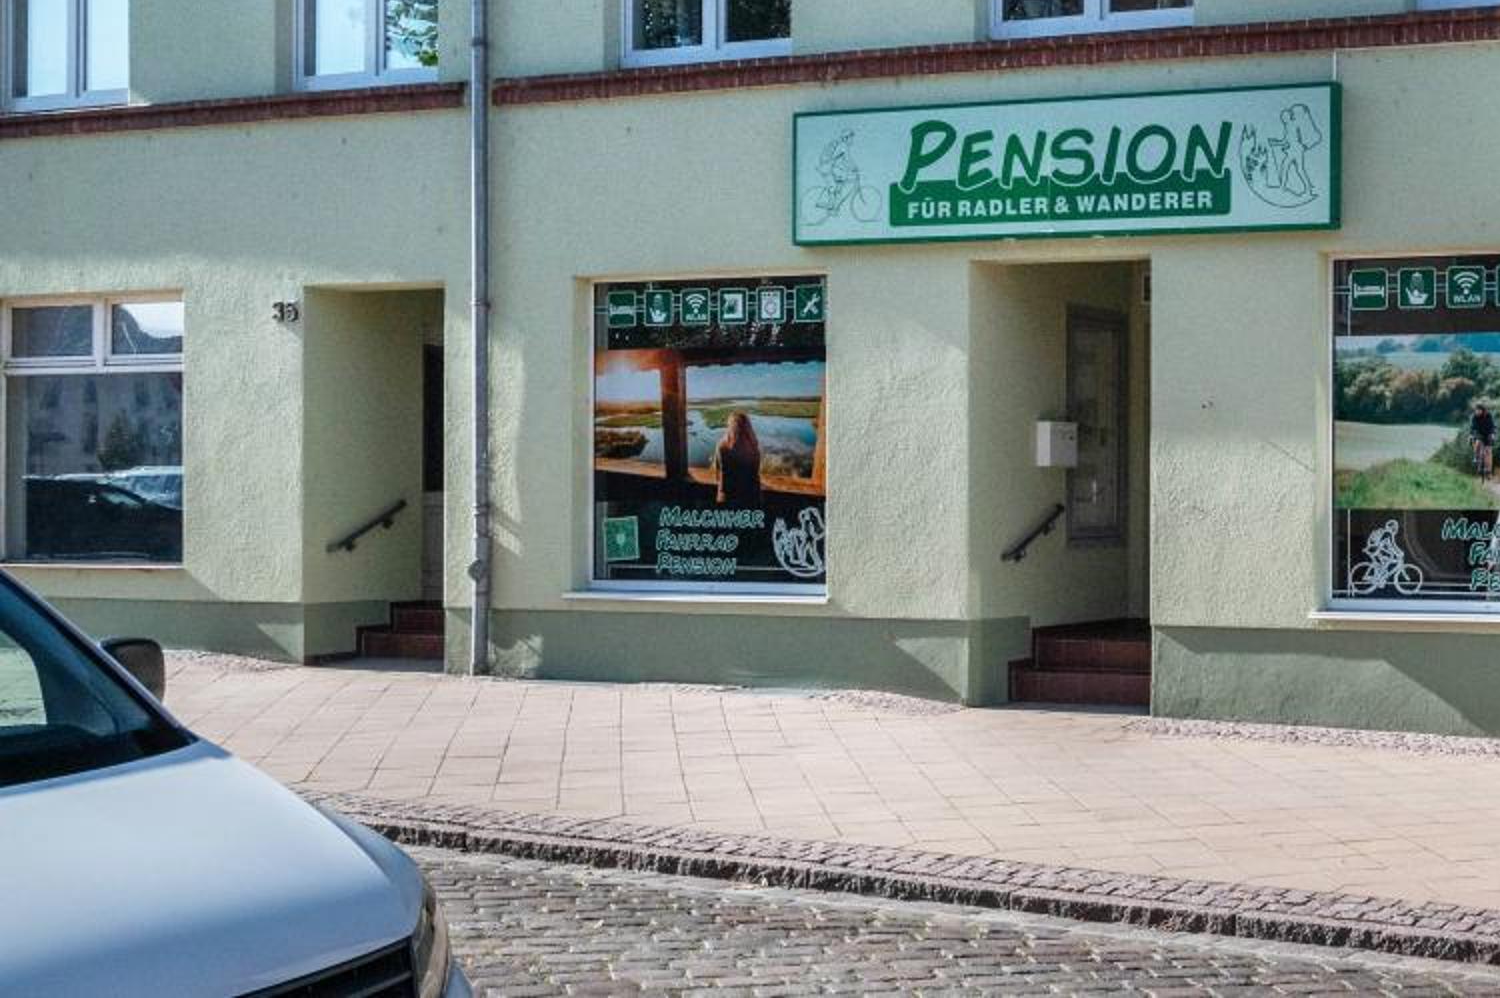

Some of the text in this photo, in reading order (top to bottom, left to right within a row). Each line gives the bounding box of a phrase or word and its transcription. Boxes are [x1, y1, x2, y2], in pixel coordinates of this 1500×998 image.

[900, 119, 1232, 193] PENSION
[906, 191, 1214, 219] FÜR RADLER & WANDERER
[655, 528, 739, 553] FAHRRAD
[656, 552, 737, 575] PENSION
